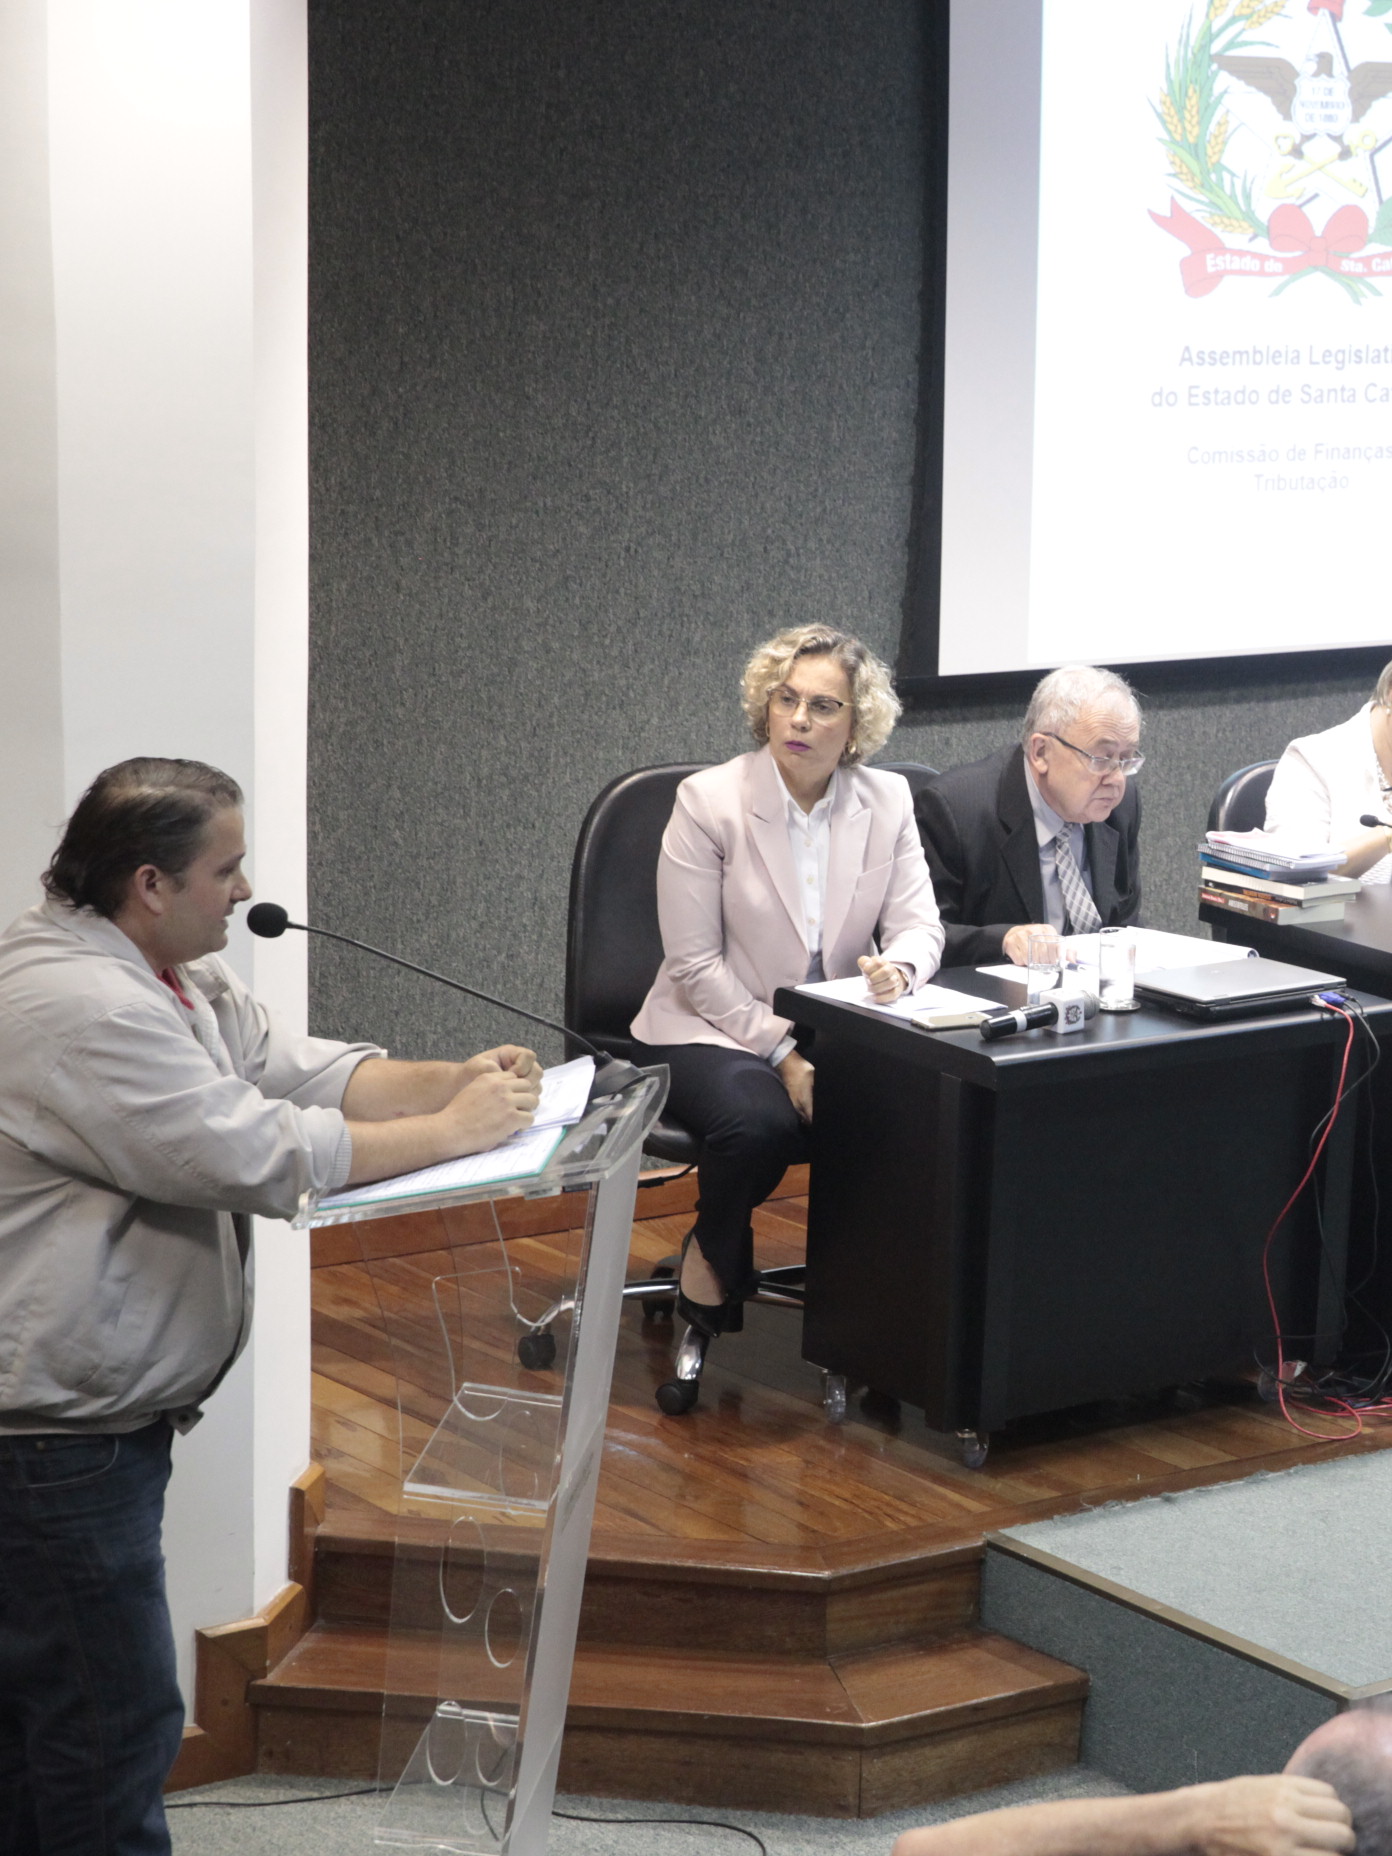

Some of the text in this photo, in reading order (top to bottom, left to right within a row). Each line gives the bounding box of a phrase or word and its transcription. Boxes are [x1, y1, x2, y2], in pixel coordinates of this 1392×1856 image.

[1206, 252, 1260, 274] Estado
[1179, 345, 1301, 367] Assembleia
[1151, 386, 1179, 408] do
[1187, 384, 1260, 407] Estado
[1268, 384, 1292, 405] de
[1300, 383, 1357, 405] Santa
[1187, 443, 1280, 465] Comissão
[1286, 443, 1307, 462] de
[1253, 469, 1350, 493] Tributação
